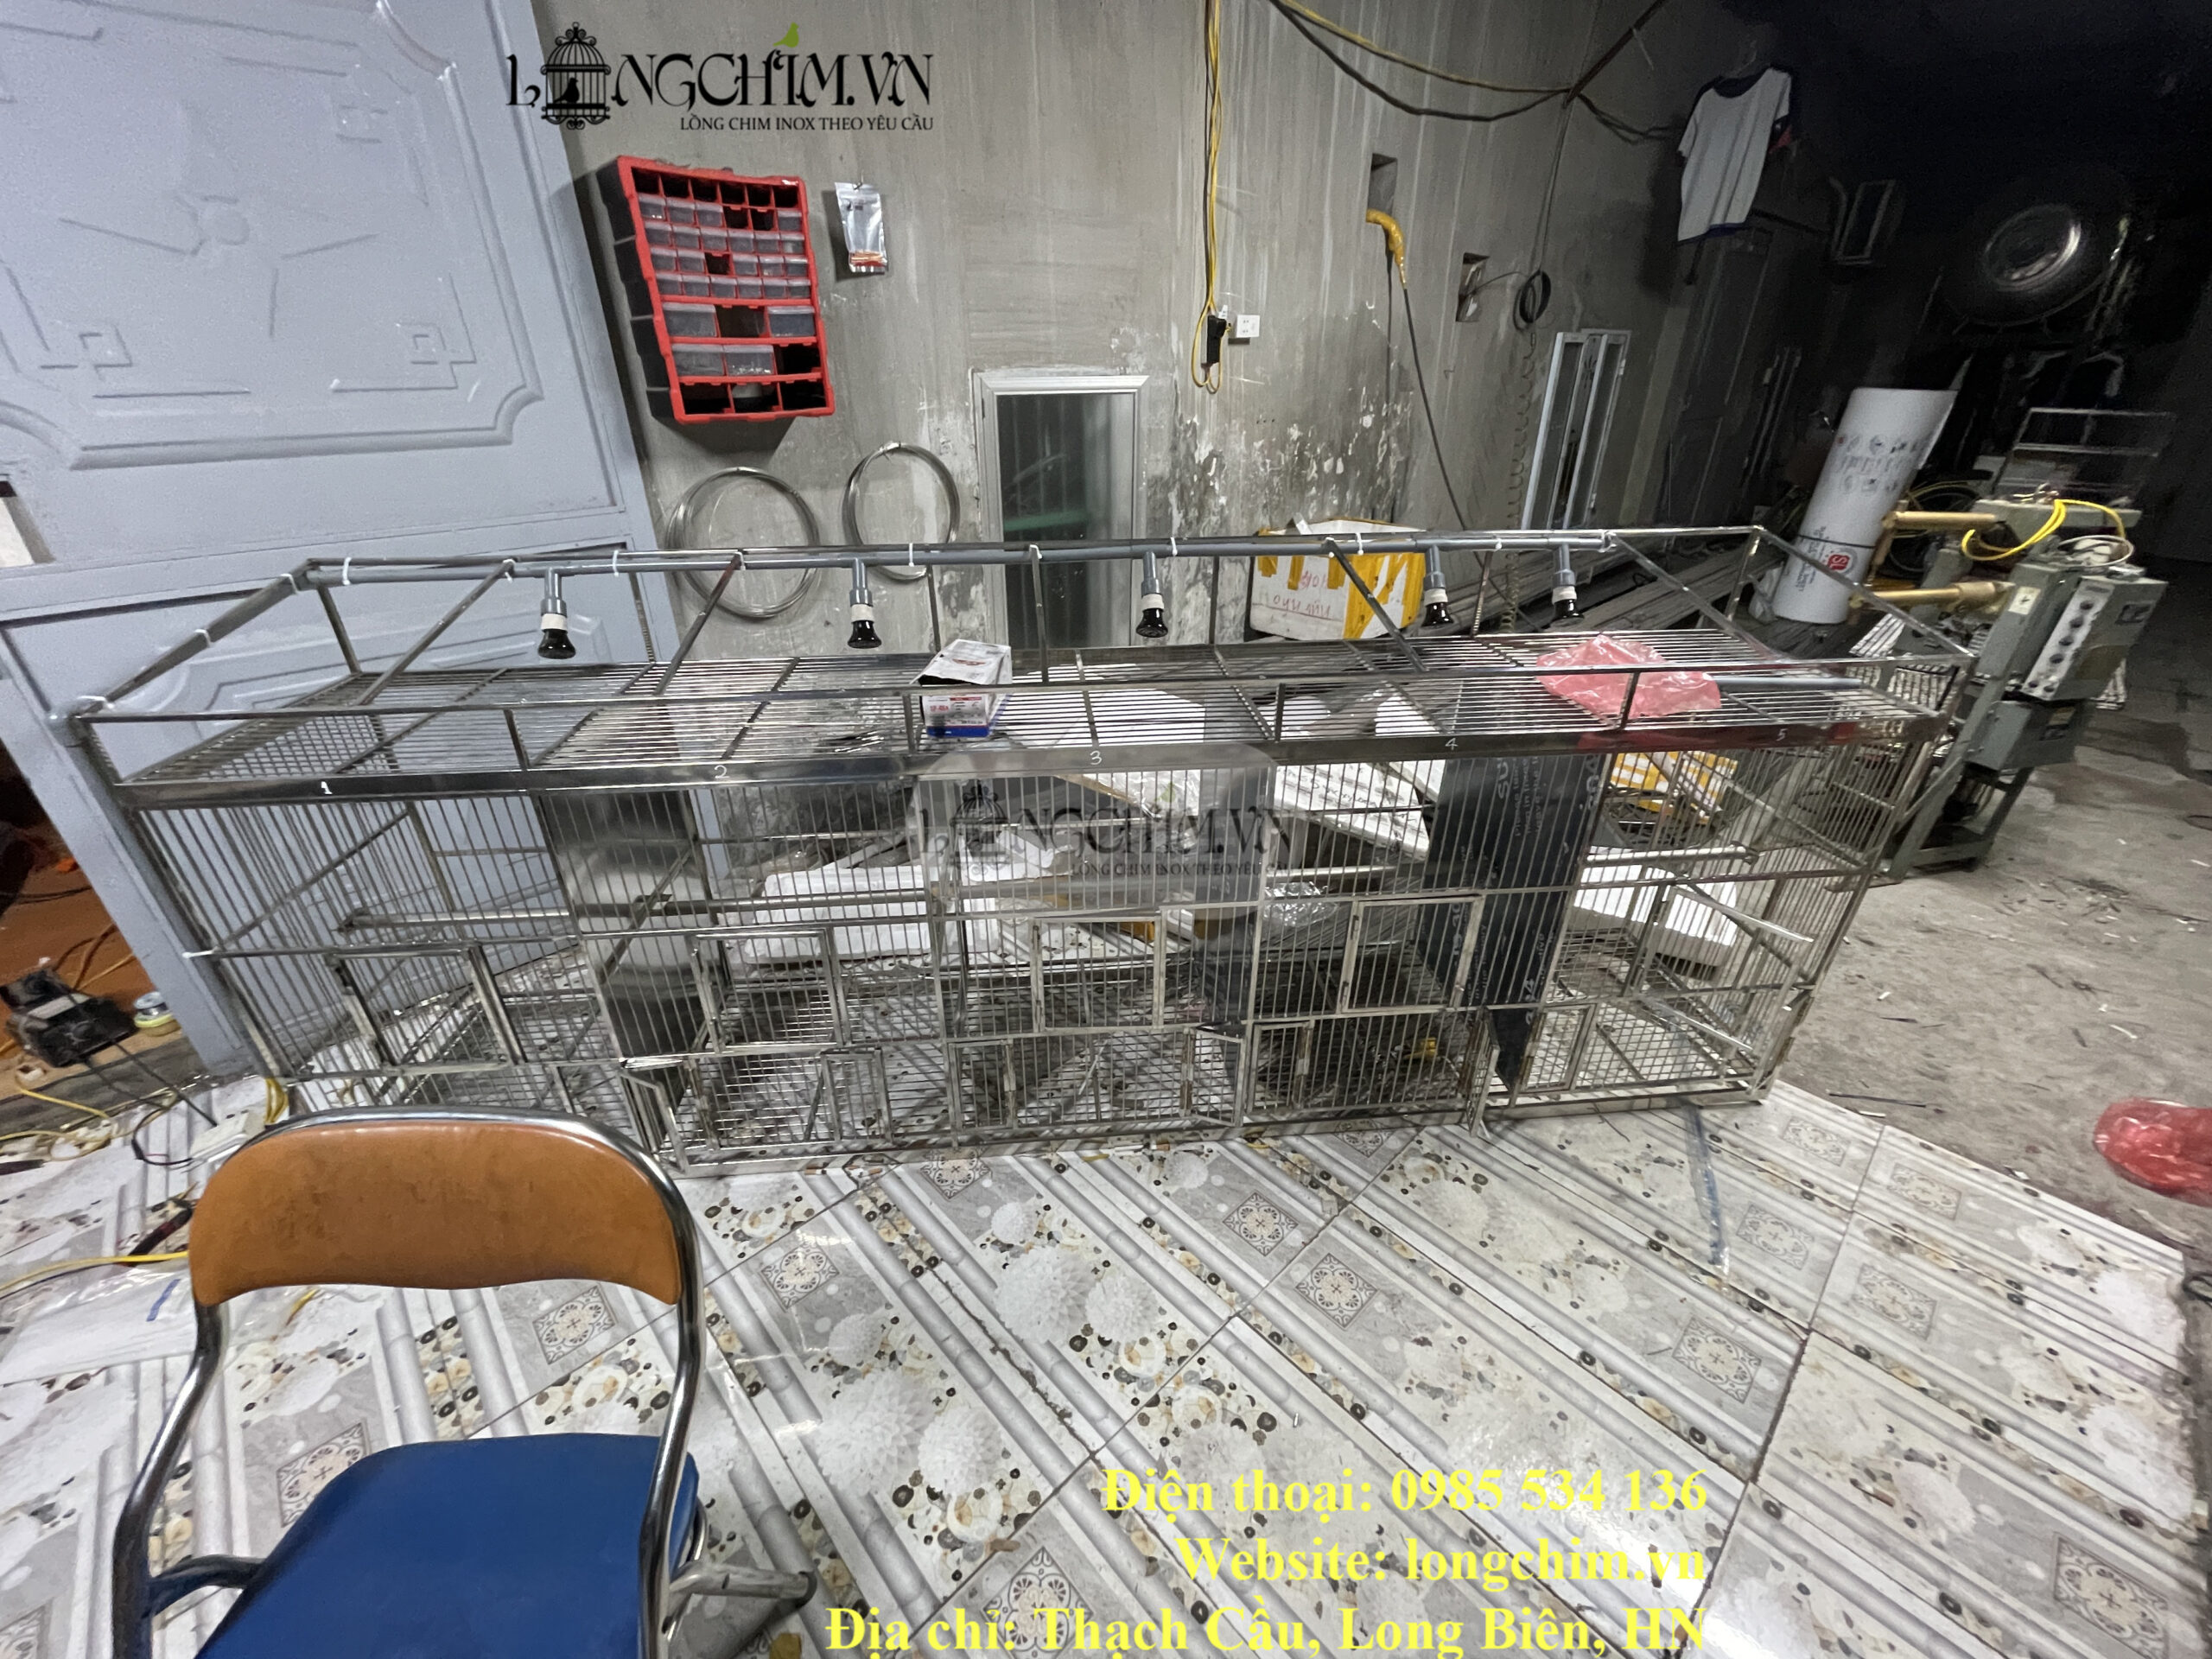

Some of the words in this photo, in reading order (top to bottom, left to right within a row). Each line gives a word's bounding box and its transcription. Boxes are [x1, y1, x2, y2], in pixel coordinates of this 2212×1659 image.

[1776, 728, 1788, 741] 5
[1445, 737, 1459, 751] 4
[1090, 750, 1103, 766] 3
[714, 765, 730, 779] 2
[321, 781, 333, 795] 1
